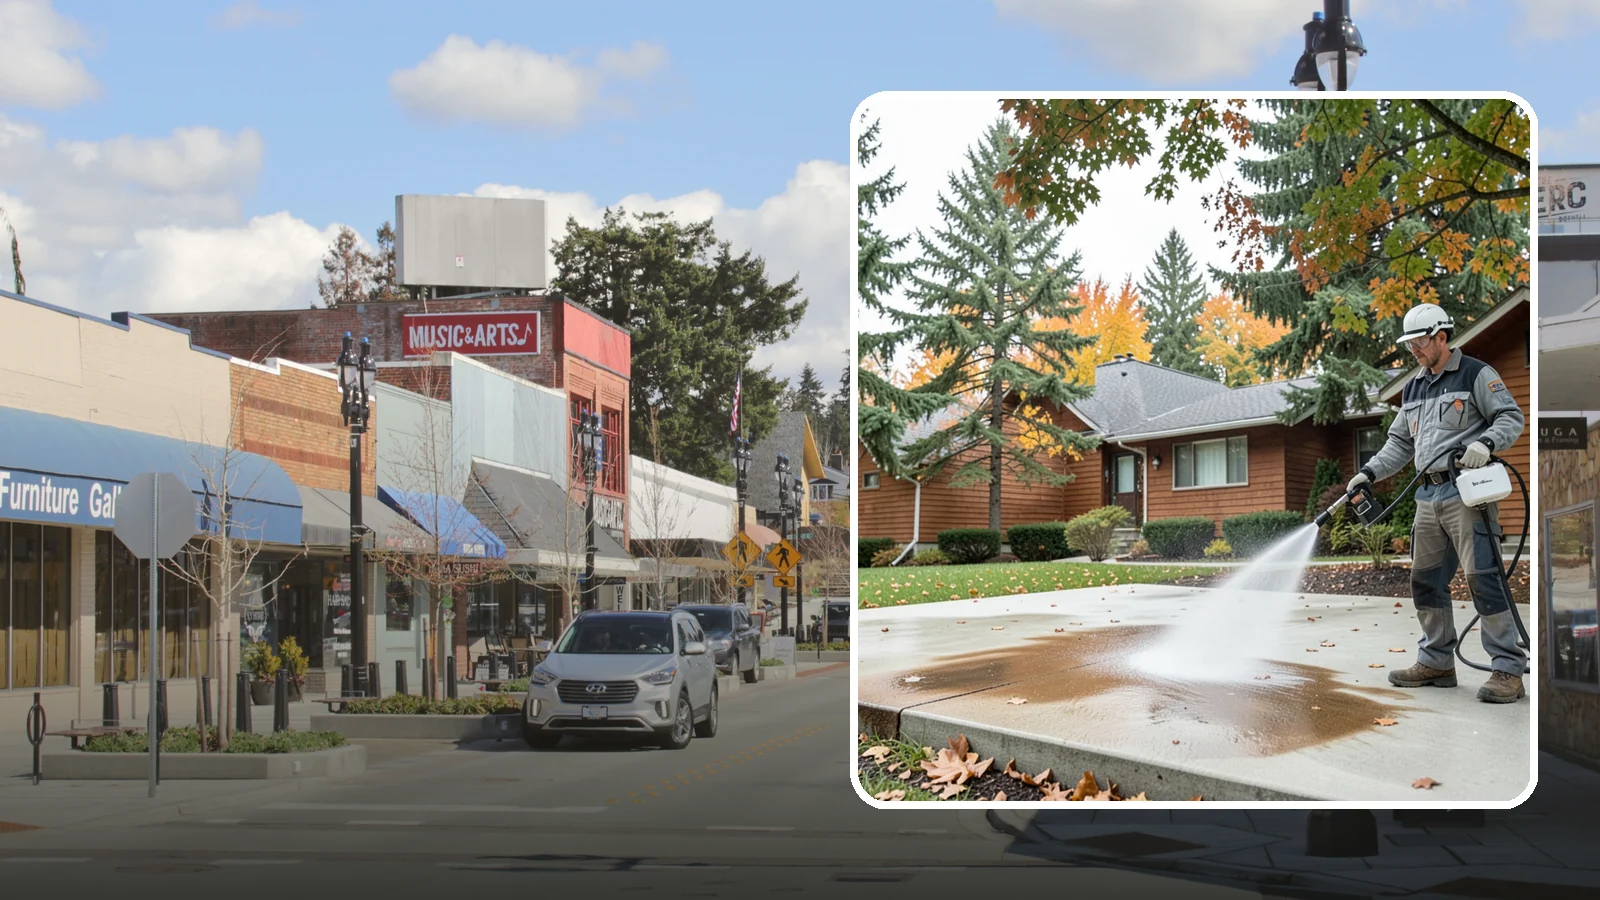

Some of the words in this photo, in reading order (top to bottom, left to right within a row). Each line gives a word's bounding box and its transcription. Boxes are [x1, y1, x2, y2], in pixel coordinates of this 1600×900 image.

[409, 322, 520, 349] MUSIC&ARTS
[0, 471, 80, 515] Furniture
[89, 482, 122, 519] Gal
